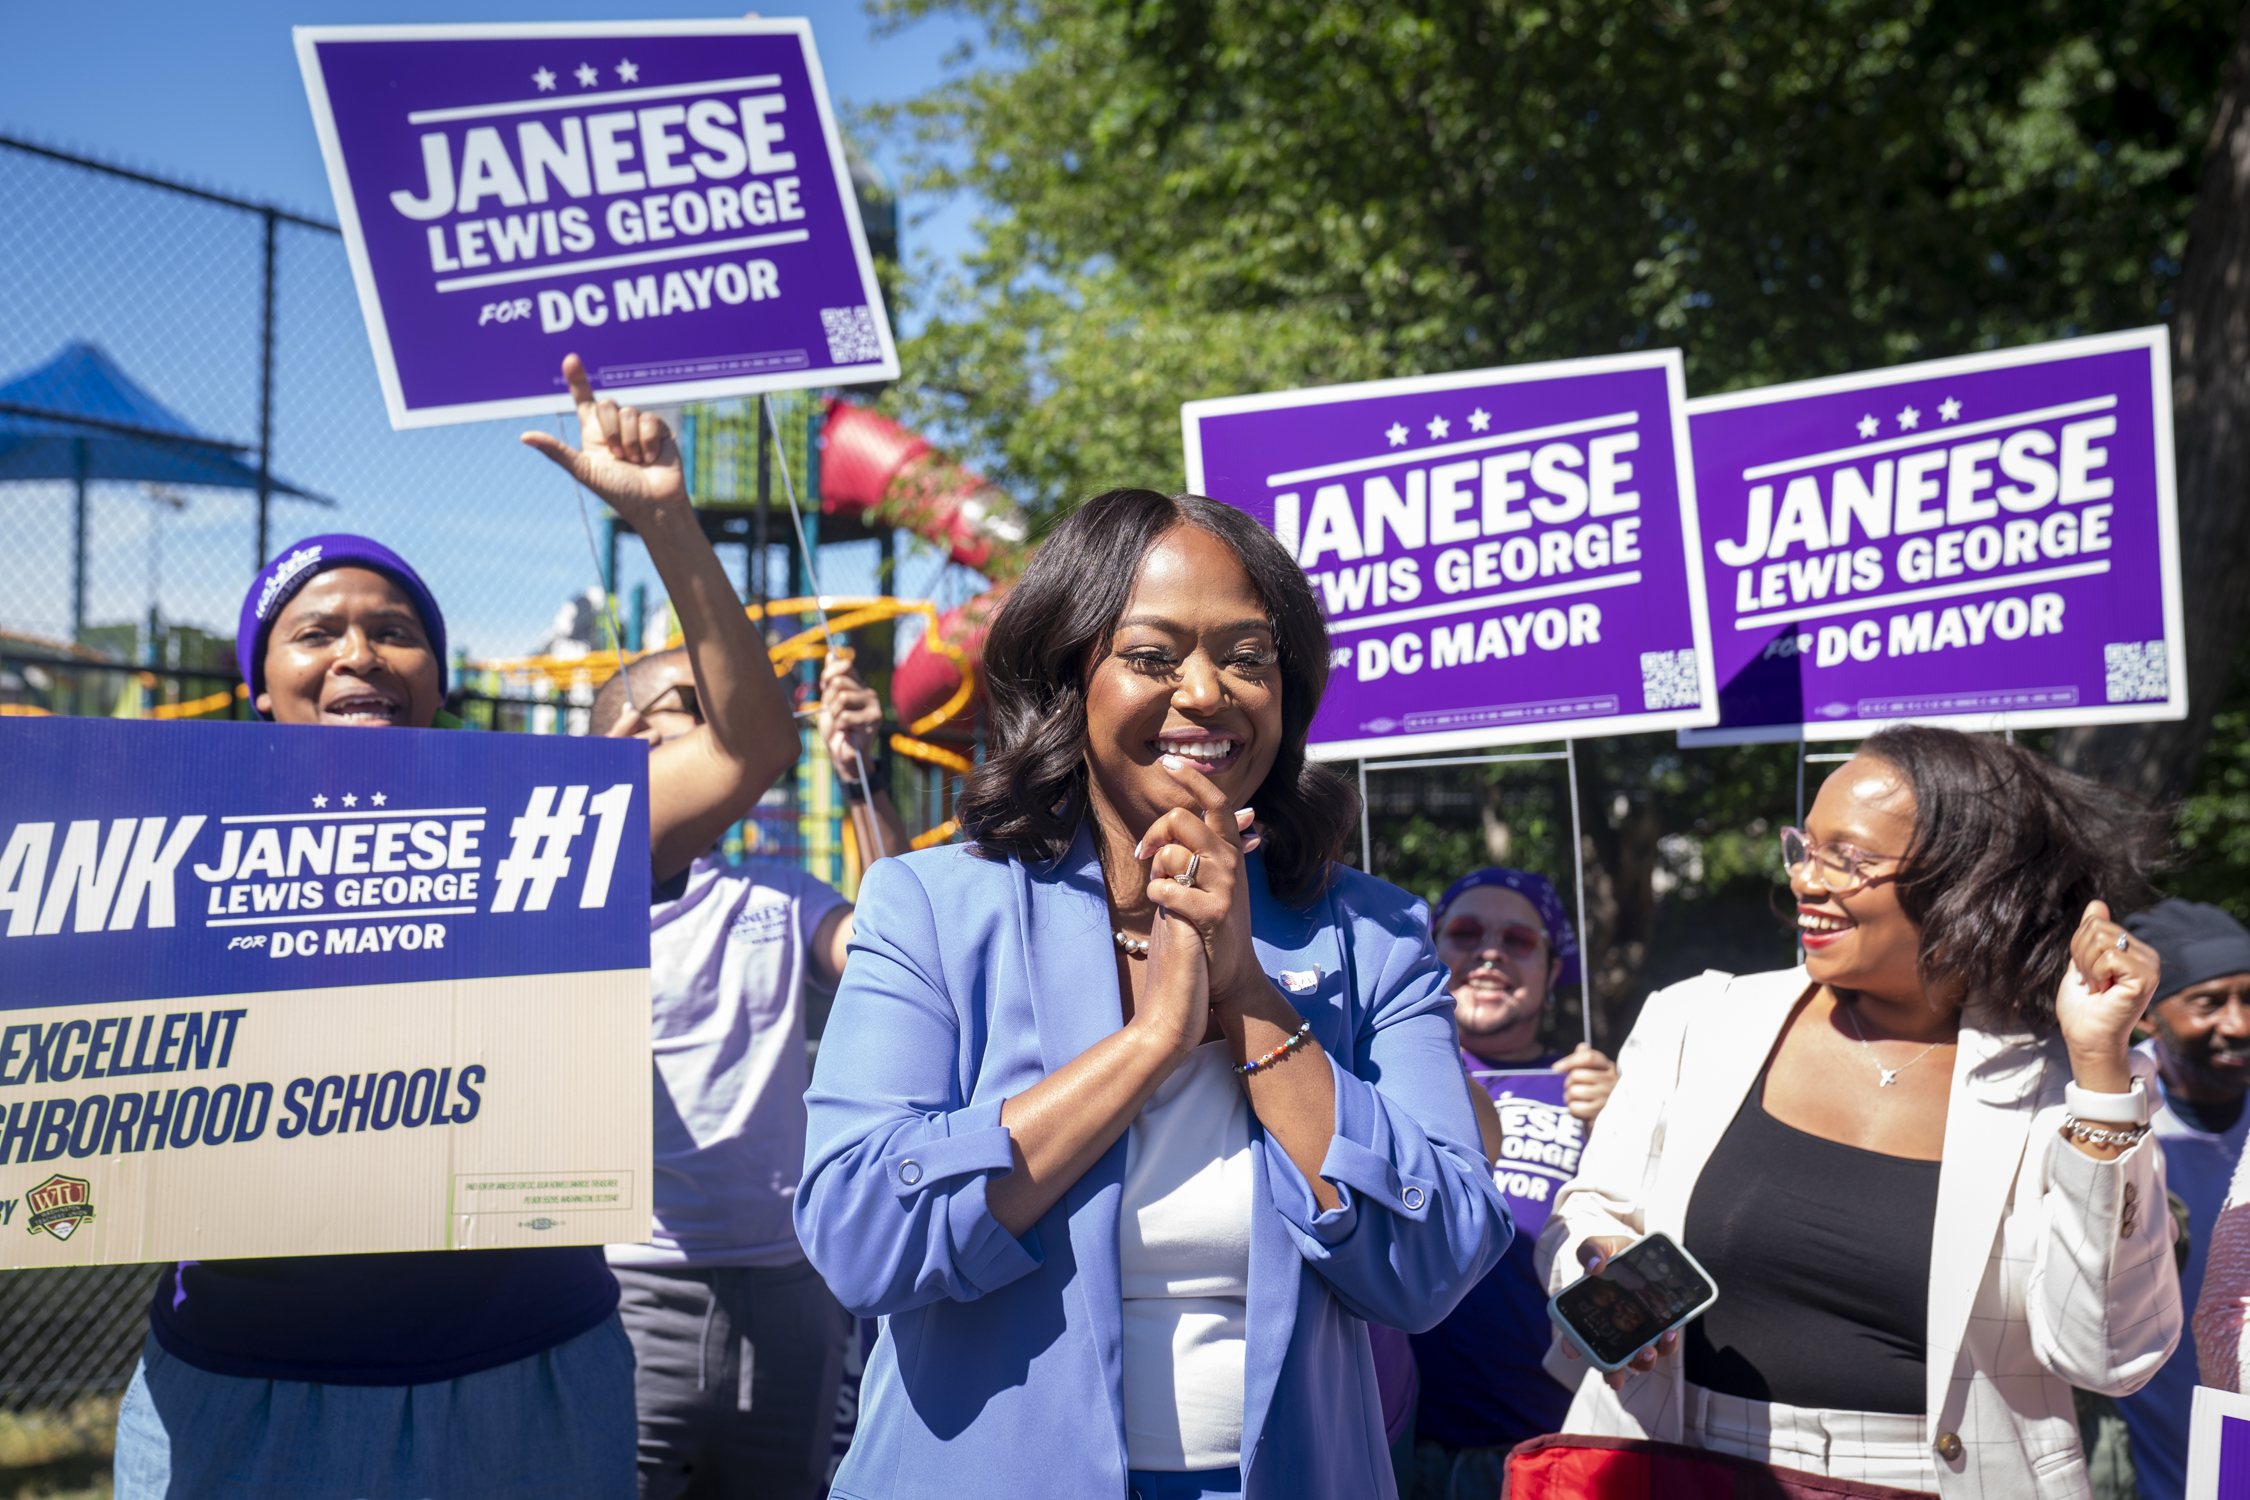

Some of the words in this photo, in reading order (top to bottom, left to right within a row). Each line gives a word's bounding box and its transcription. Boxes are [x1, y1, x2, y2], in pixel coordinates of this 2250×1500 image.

[389, 93, 797, 220] JANEESE
[427, 206, 595, 273] LEWIS
[605, 176, 805, 245] GEORGE
[478, 298, 532, 327] FOR
[537, 284, 609, 334] DC
[613, 259, 780, 322] MAYOR
[1715, 415, 2117, 567] JANEESE
[1306, 557, 1422, 615] WIS
[1434, 517, 1641, 594] GEORGE
[1735, 546, 1885, 613] LEWIS
[1897, 503, 2114, 584] GEORGE
[1357, 632, 1424, 682] DC
[1430, 603, 1602, 671] MAYOR
[1763, 633, 1814, 660] FOR
[1815, 619, 1882, 668] DC
[1887, 592, 2066, 657] MAYOR
[194, 819, 486, 882] JANEESE
[490, 783, 633, 913] #1
[207, 881, 324, 915] LEWIS
[333, 872, 480, 908] GEORGE
[227, 934, 267, 950] FOR
[269, 928, 319, 959] DC
[324, 923, 446, 955] MAYOR
[0, 1008, 248, 1087] EXCELLENT
[0, 1082, 273, 1166] HBORHOOD
[276, 1064, 486, 1140] SCHOOLS
[1493, 1170, 1550, 1202] YOR
[1501, 1135, 1580, 1173] ORGE
[34, 1183, 83, 1210] WTU
